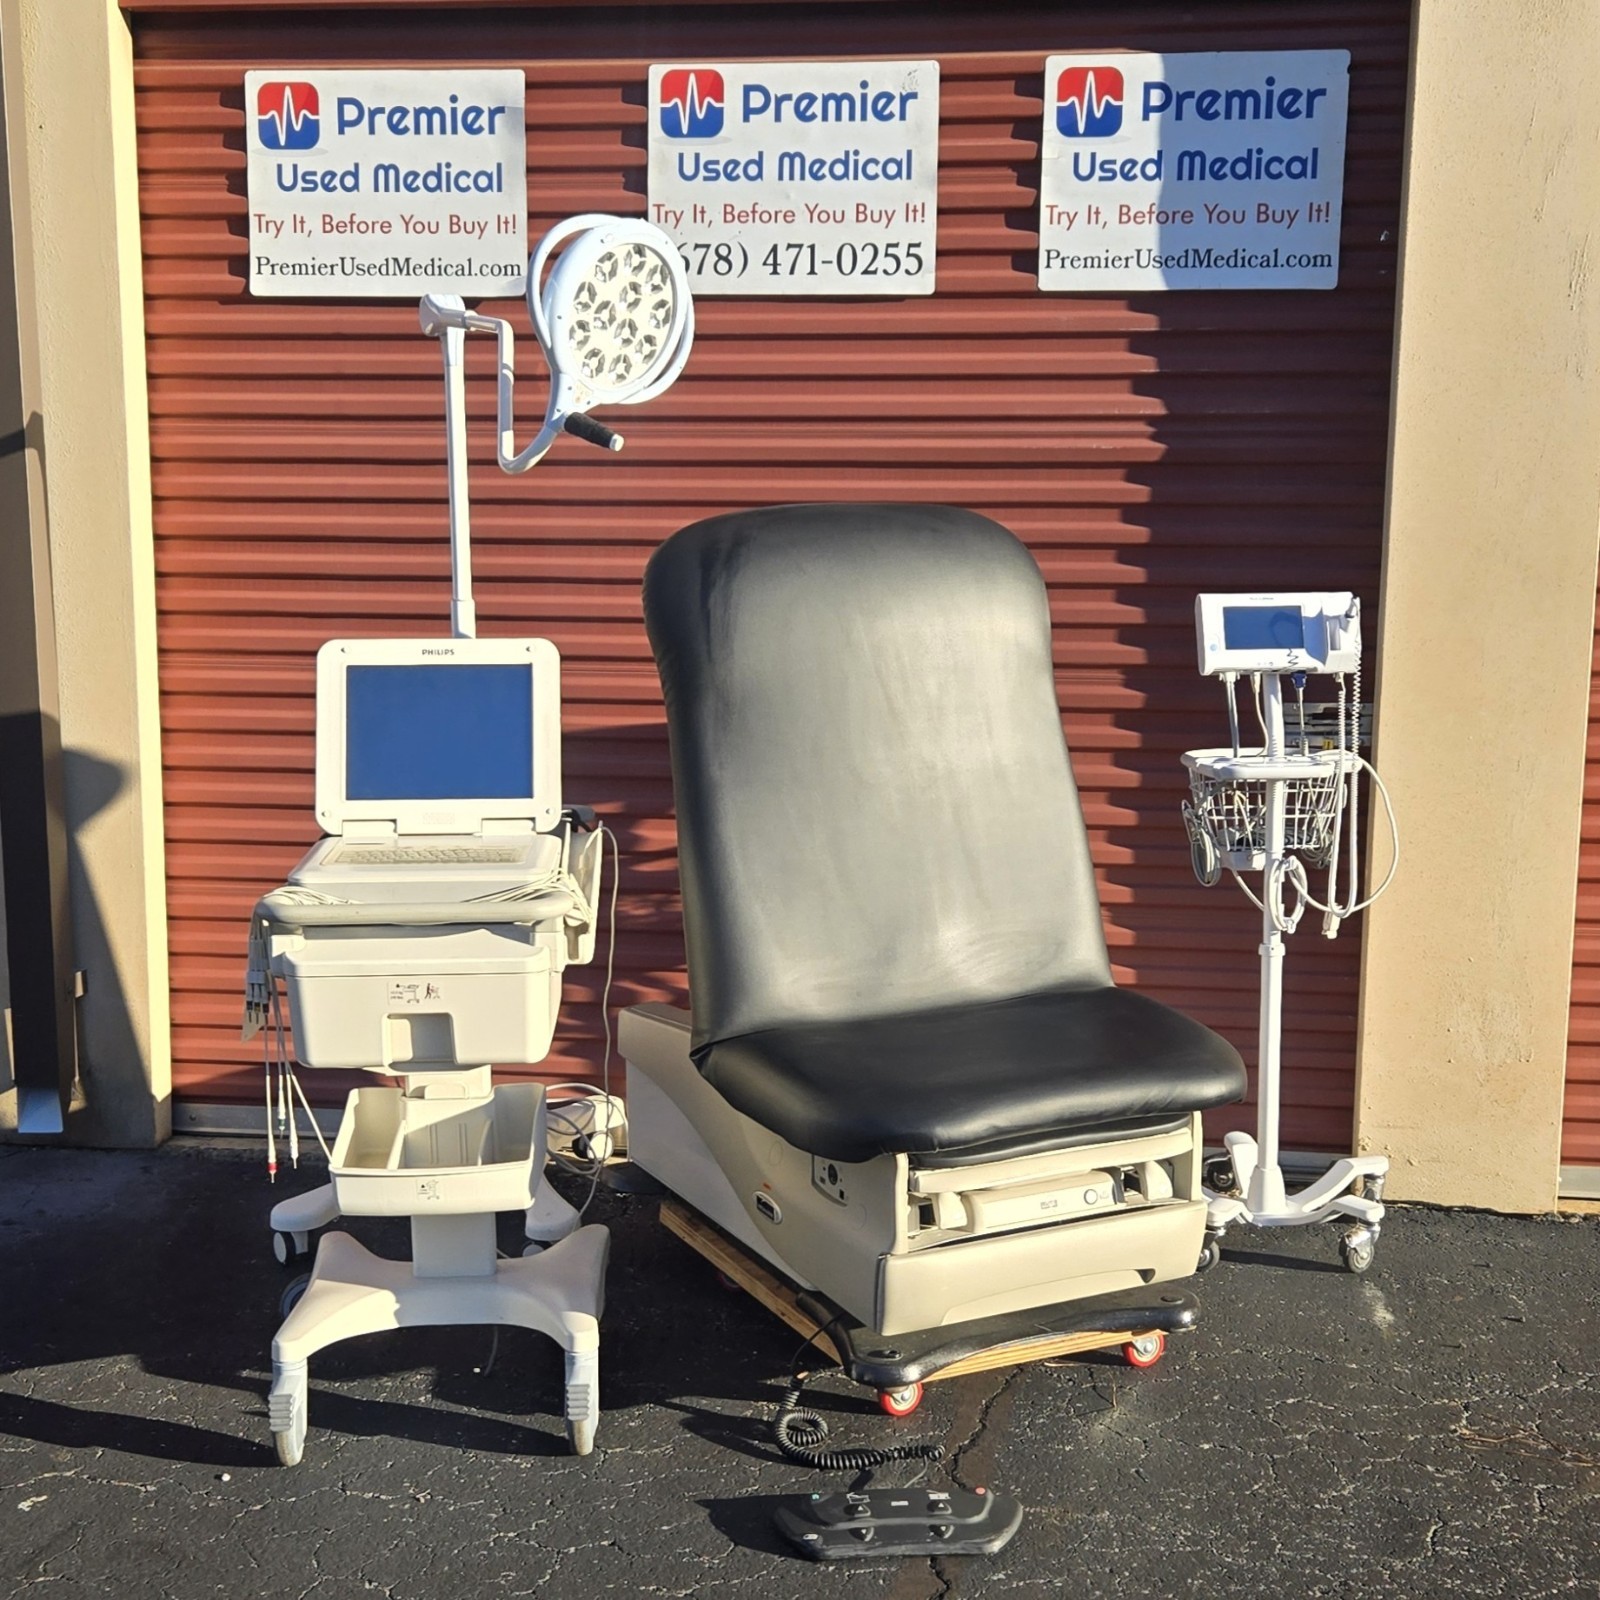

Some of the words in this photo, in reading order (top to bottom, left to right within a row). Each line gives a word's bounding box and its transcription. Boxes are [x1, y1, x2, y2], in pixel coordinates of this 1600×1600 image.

[743, 80, 918, 122] Premier
[1142, 76, 1326, 121] Premier
[337, 94, 505, 135] Premier
[277, 163, 359, 192] Used
[373, 162, 502, 192] Medical
[678, 151, 763, 181] Used
[778, 150, 912, 181] Medical
[1073, 150, 1163, 181] Used
[1177, 148, 1318, 181] Medical
[254, 214, 284, 238] Try
[293, 214, 312, 238] It,
[322, 213, 392, 234] Before
[400, 215, 439, 234] You
[449, 214, 488, 239] Buy
[497, 214, 517, 234] It!
[653, 204, 684, 229] Try
[693, 204, 712, 228] It,
[723, 202, 795, 223] Before
[805, 203, 845, 223] You
[856, 203, 896, 228] Buy
[905, 202, 926, 222] It!
[1046, 205, 1078, 230] Try
[1087, 204, 1107, 229] It,
[1119, 203, 1193, 224] Before
[1204, 203, 1245, 224] You
[1257, 203, 1299, 229] Buy
[1308, 201, 1330, 223] It!
[256, 257, 521, 277] PremierUsedMedical.com
[762, 242, 923, 276] 471-0255
[1045, 248, 1332, 269] PremierUsedMedical.com
[421, 648, 455, 656] PHILIPS
